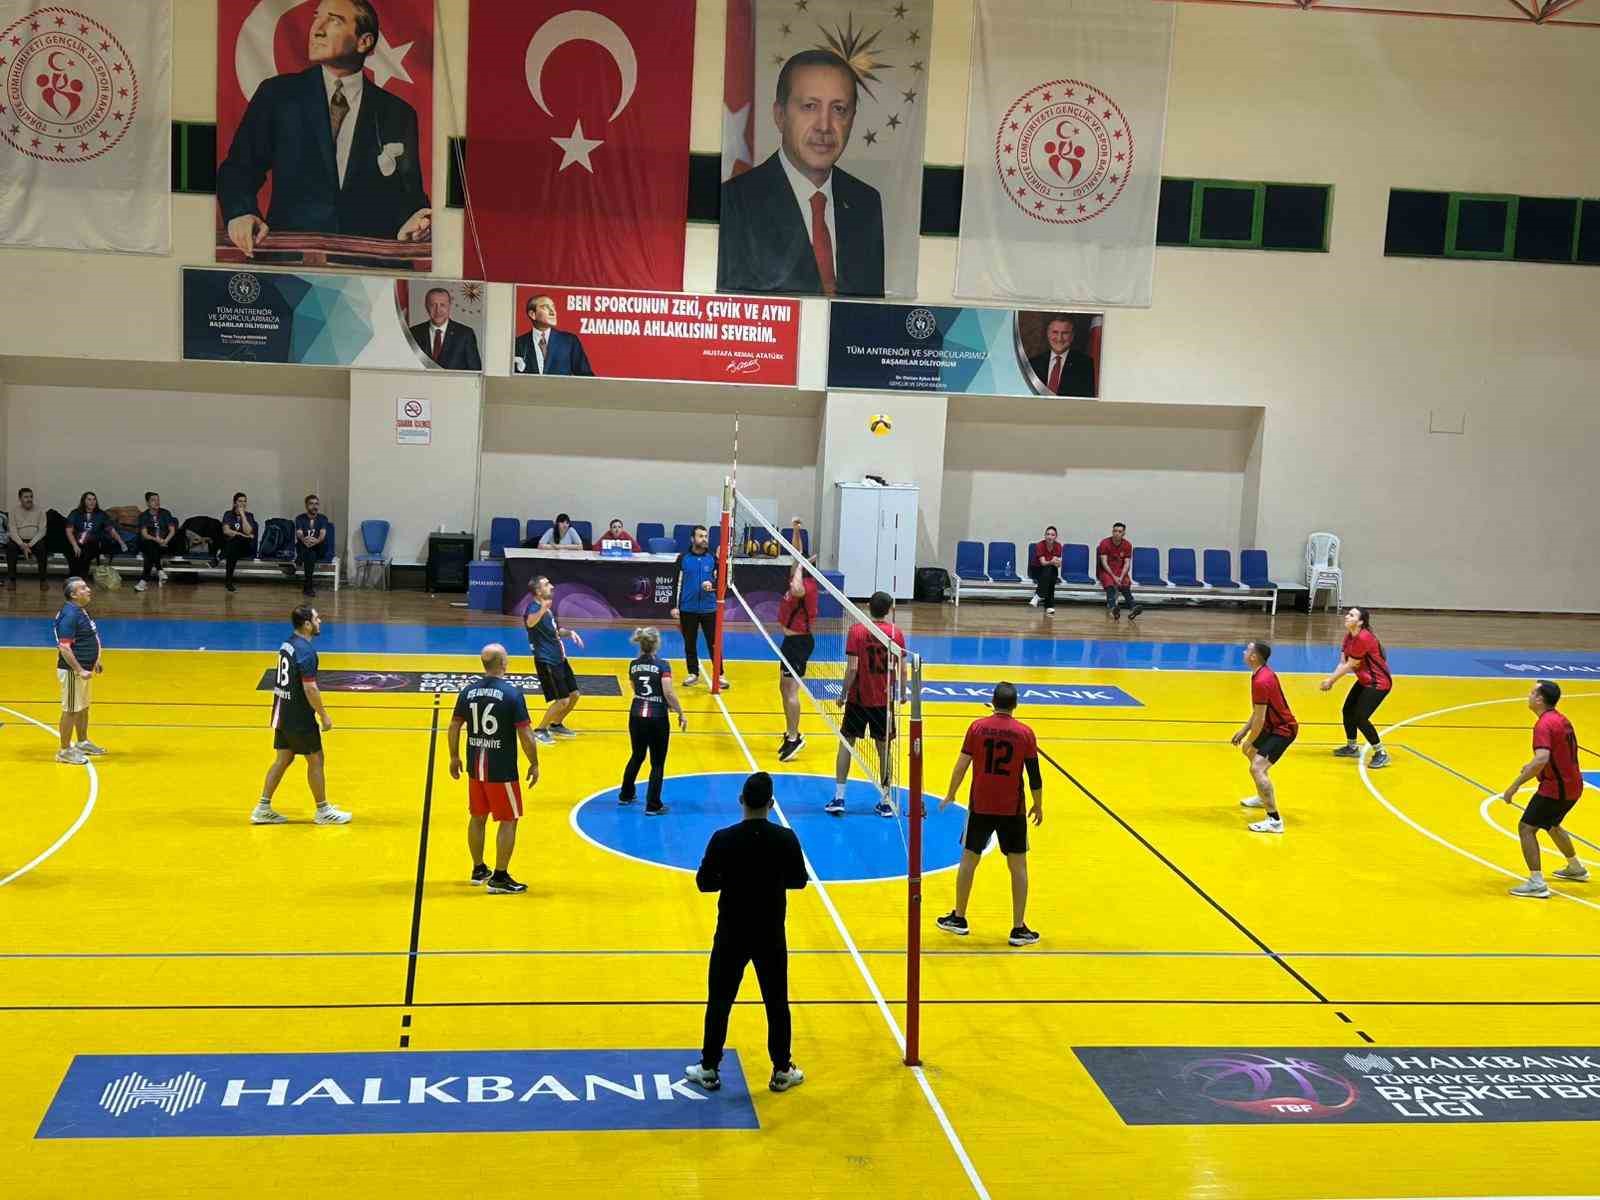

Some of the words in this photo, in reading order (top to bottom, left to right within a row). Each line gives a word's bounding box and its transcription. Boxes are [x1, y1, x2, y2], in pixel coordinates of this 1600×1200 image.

[45, 35, 86, 55] GENÇLİK
[86, 51, 98, 66] VE
[95, 65, 110, 93] SPOR
[1055, 106, 1091, 123] GENÇLİK
[1091, 120, 1101, 132] VE
[1097, 132, 1108, 161] SPOR
[216, 305, 232, 314] TÜM
[234, 306, 272, 316] ANTRENÖR
[567, 295, 591, 312] BEN
[594, 296, 669, 315] SPORCUNUN
[672, 296, 702, 320] ZEKİ,
[706, 298, 741, 321] ÇEVİK
[744, 305, 759, 320] VE
[762, 305, 791, 322] AYNI
[580, 318, 641, 336] ZAMANDA
[643, 320, 718, 340] AHLAKLISINI
[721, 322, 777, 343] SEVERİM.
[846, 345, 865, 355] TÜM
[866, 346, 910, 357] ANTRENÖR
[911, 350, 921, 358] VE
[881, 358, 919, 367] BAŞARILAR
[919, 360, 957, 368] DİLİYORUM
[639, 676, 653, 696] 3
[905, 684, 1114, 700] ALKANK
[469, 702, 498, 735] 16
[984, 739, 1013, 776] 12
[1391, 1055, 1600, 1069] HALKBANK
[1363, 1073, 1484, 1085] TÜRKİYE
[221, 1074, 709, 1106] HALKBANK
[1271, 1104, 1313, 1113] TBF
